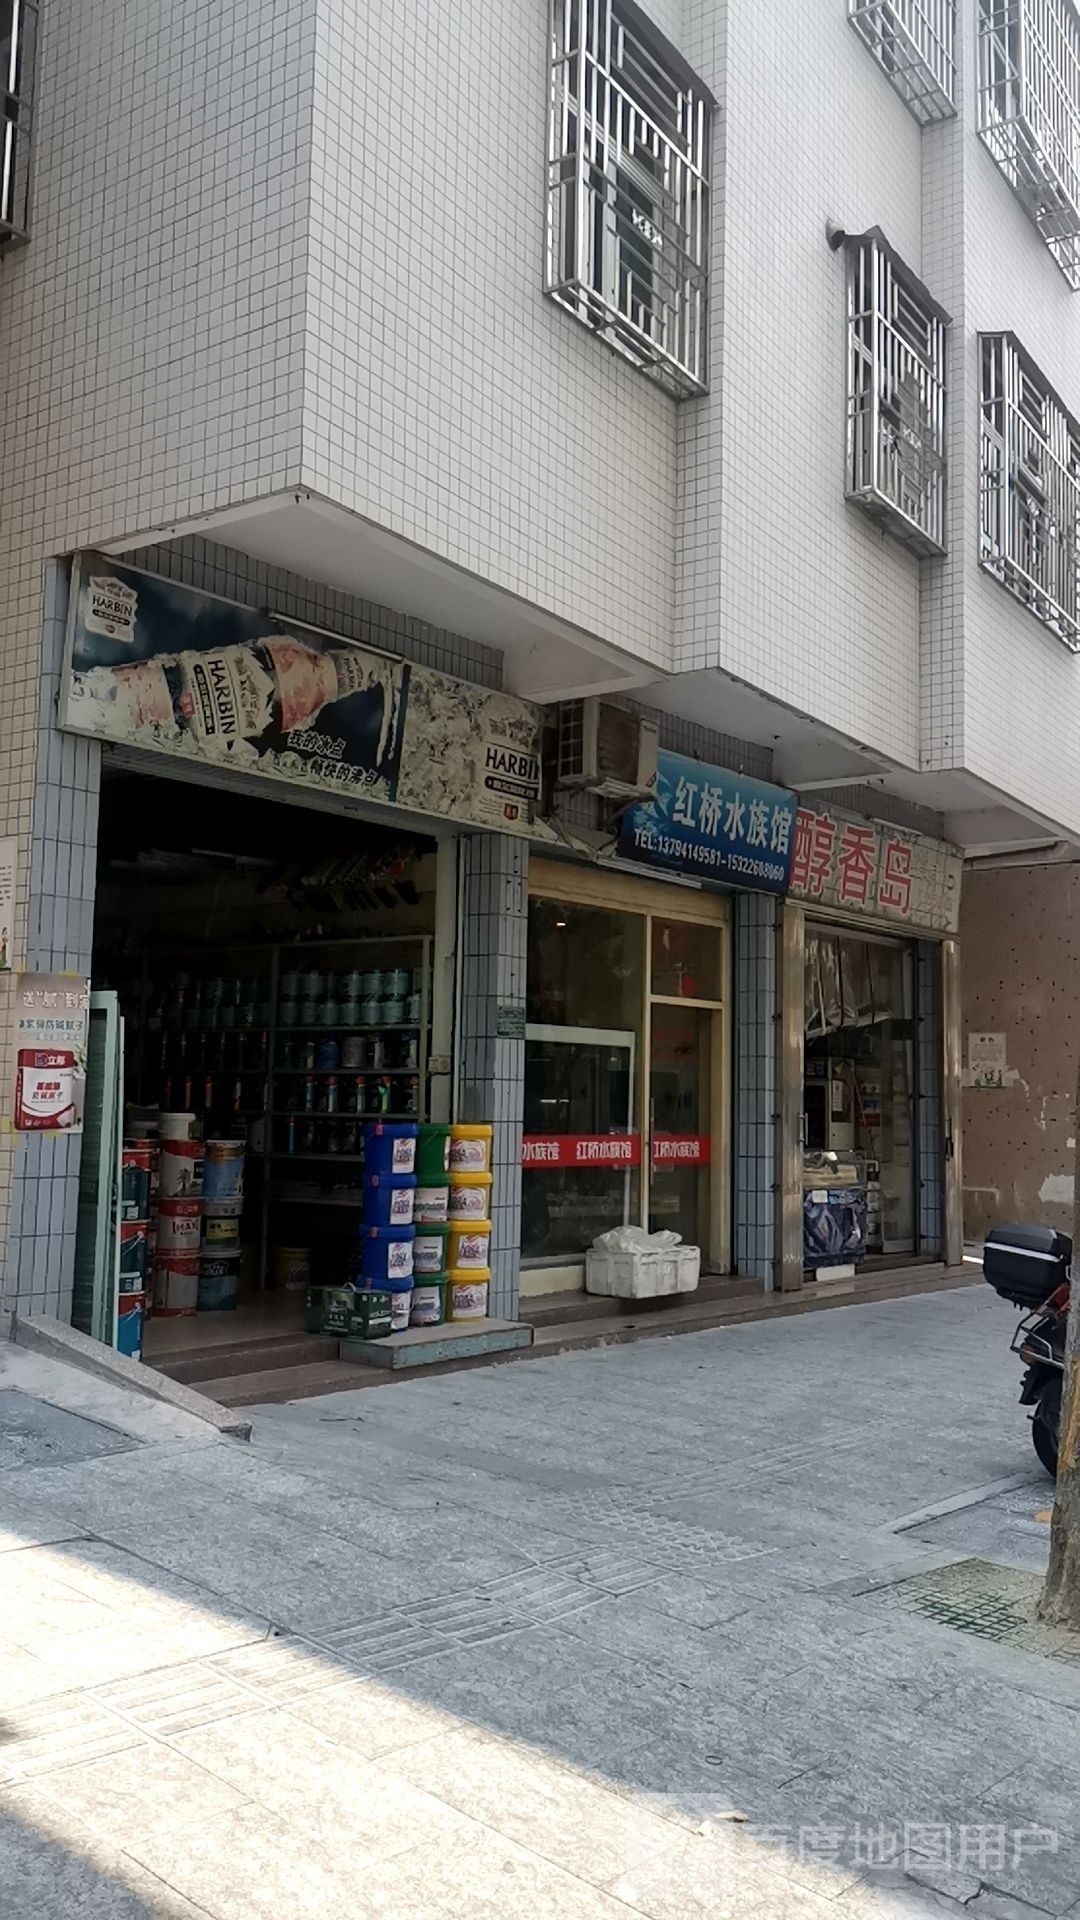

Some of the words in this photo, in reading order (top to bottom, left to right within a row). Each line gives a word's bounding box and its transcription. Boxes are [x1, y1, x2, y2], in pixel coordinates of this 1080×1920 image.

[92, 594, 133, 616] HARBIN
[207, 659, 236, 734] HARBIN
[288, 729, 346, 759] 我的冰点
[672, 776, 793, 855] 红桥水族馆
[789, 807, 914, 914] 醇香岛
[521, 1142, 560, 1161] 水族馆
[576, 1141, 632, 1160] 红桥水族馆
